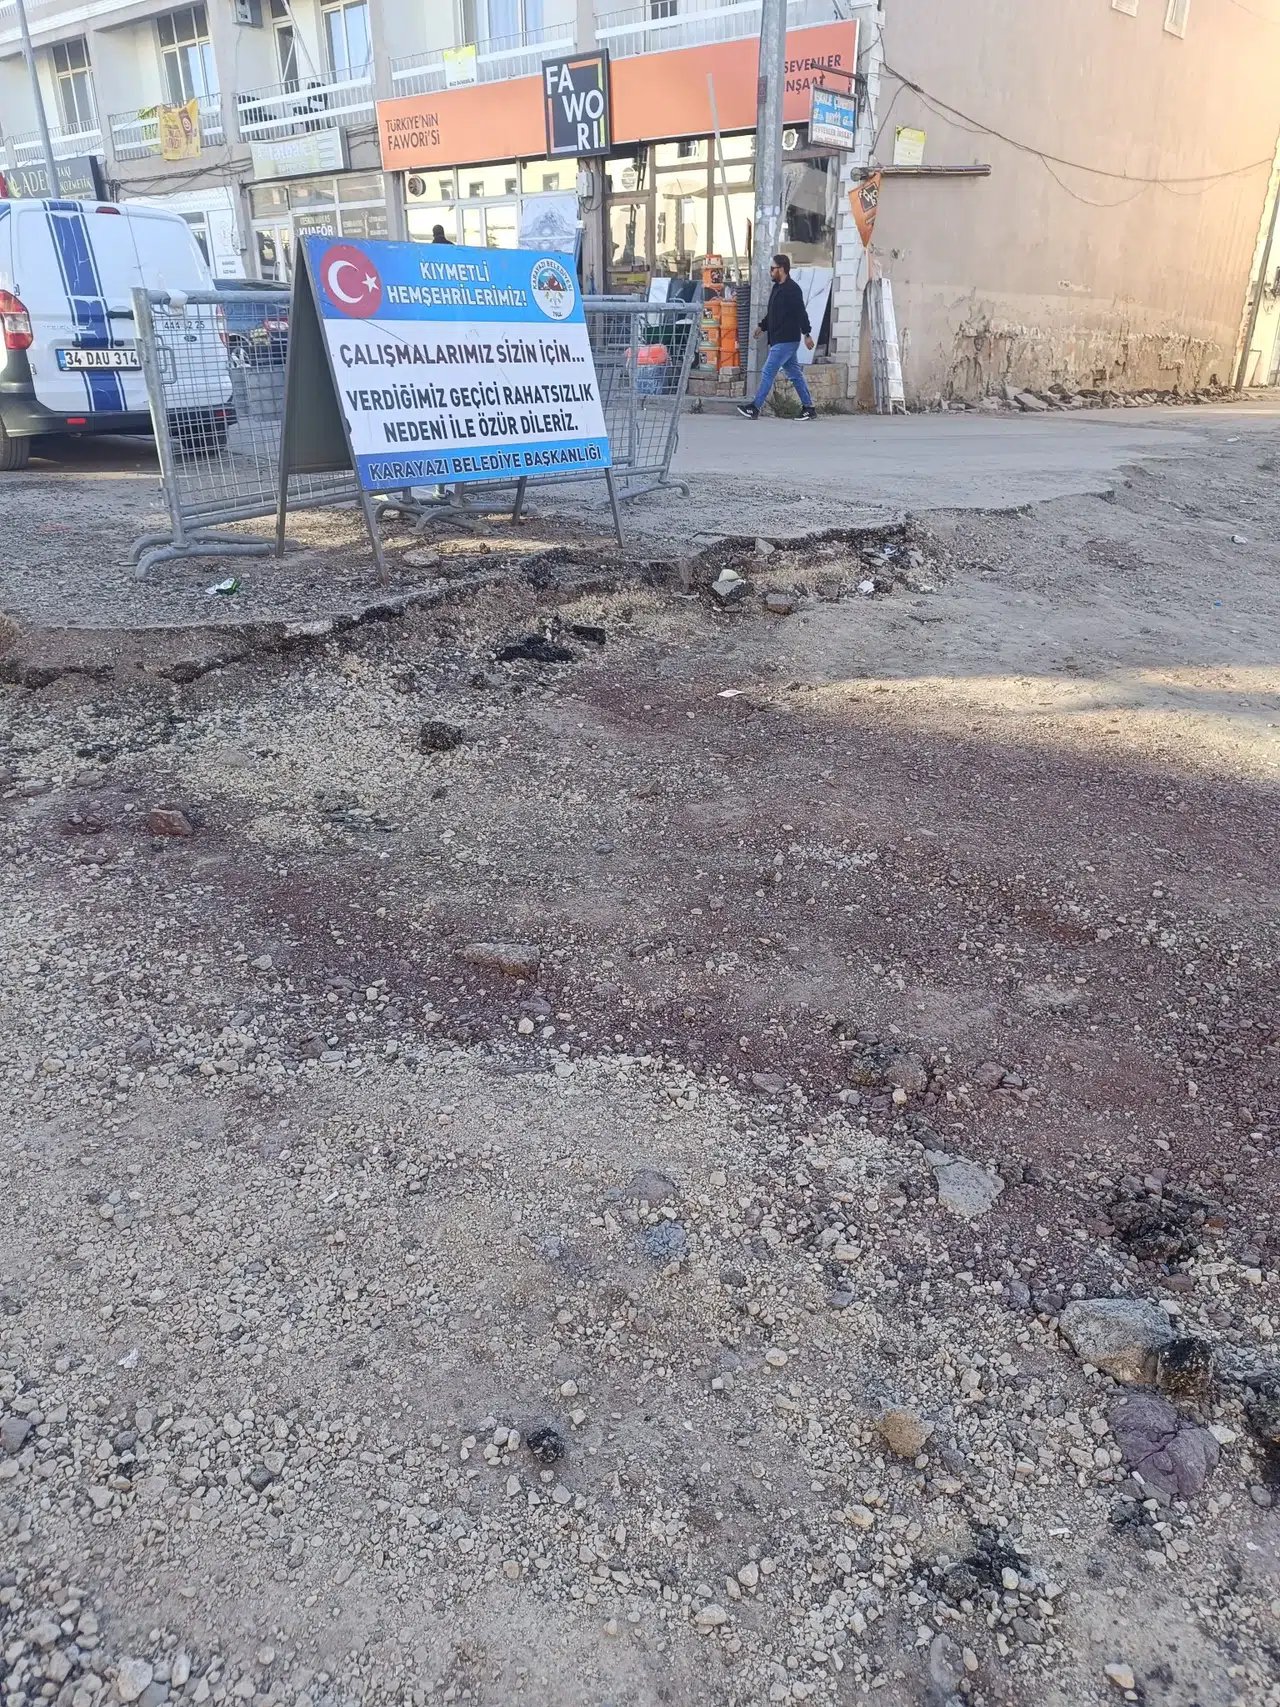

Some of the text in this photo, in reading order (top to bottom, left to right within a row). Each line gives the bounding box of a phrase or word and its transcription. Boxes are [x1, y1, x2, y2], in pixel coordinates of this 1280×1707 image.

[385, 113, 439, 132] TÜRKİYE'NİN
[388, 129, 441, 150] FAWORİ'Sİ
[299, 223, 334, 236] KUAFÖR
[419, 260, 490, 282] KIYMETLİ
[532, 261, 546, 290] KARAYAZI
[387, 284, 528, 307] HEMŞEHRİLERİMİZ!
[65, 352, 137, 365] 34 DAU 314
[340, 339, 584, 368] ÇALIŞMALARIMIZ SİZİN İÇİN...
[346, 381, 594, 411] VERDİĞİMİZ GEÇİCİ RAHATSIZLIK
[383, 408, 578, 442] NEDENİ İLE ÖZÜR DİLERİZ.
[369, 443, 601, 481] KARAYAZI BELEDİYE BAŞKANLIĞI
